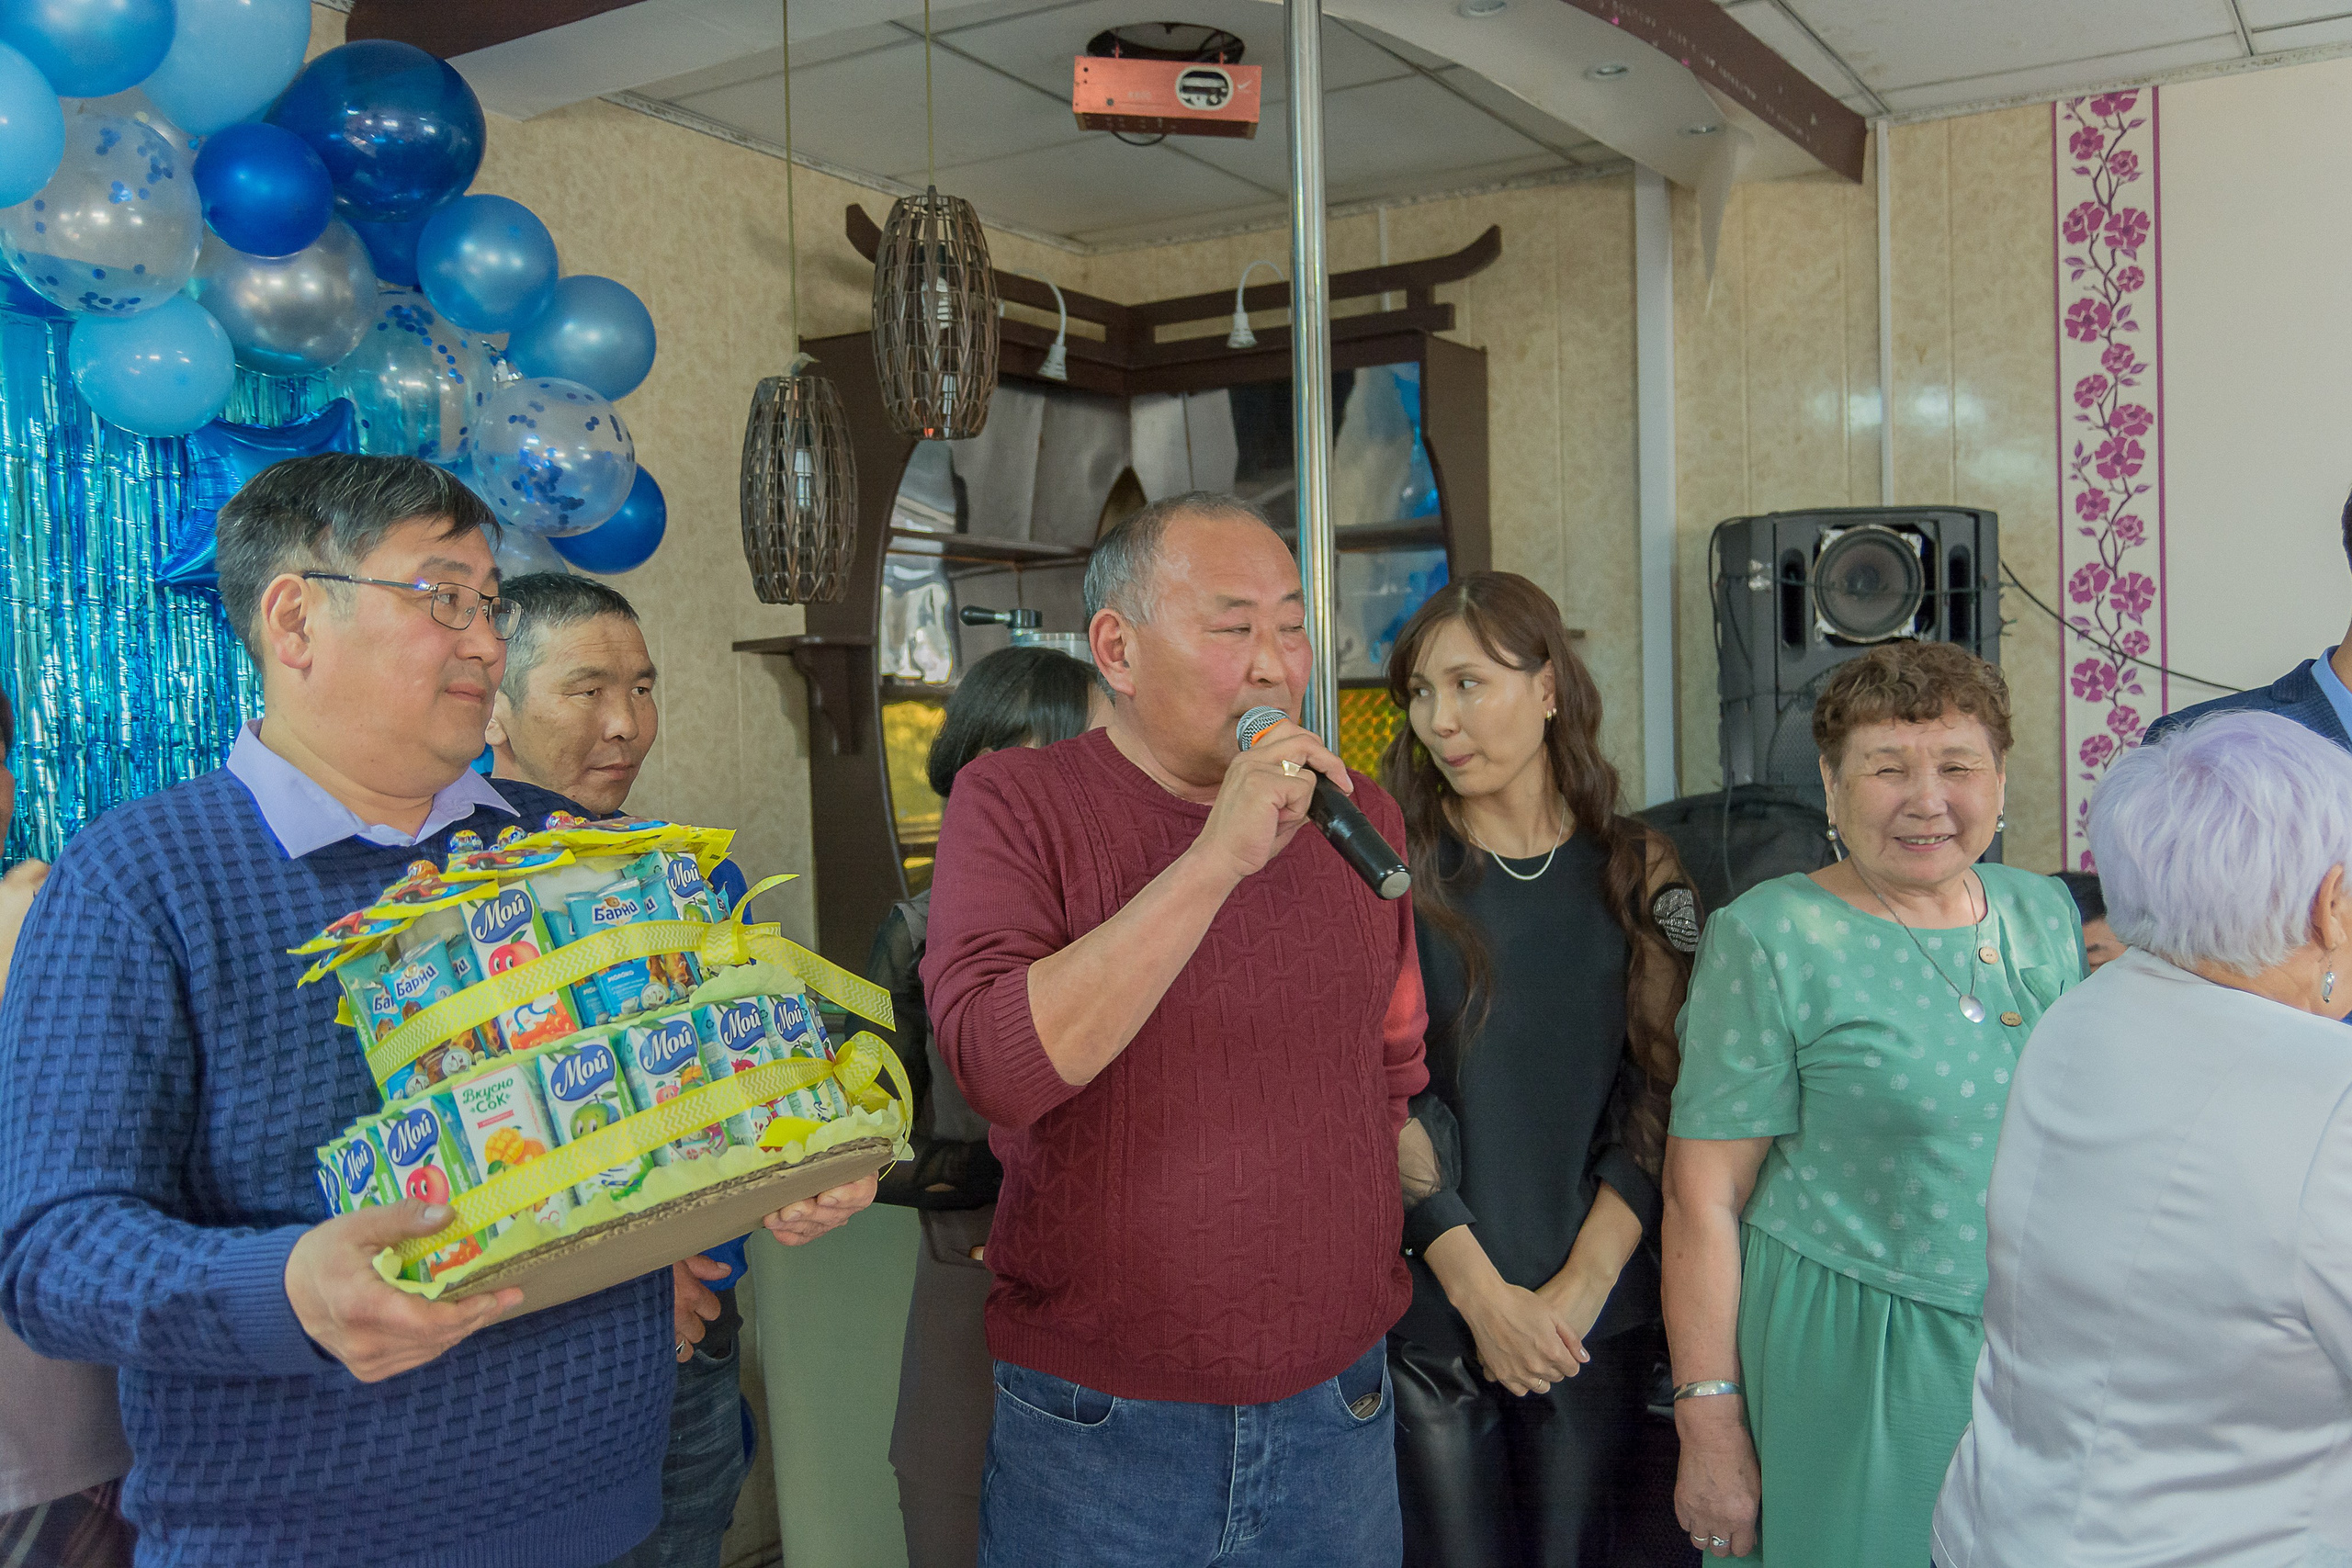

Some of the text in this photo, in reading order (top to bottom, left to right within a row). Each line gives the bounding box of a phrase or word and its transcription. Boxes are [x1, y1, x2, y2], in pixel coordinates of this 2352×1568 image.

[671, 863, 700, 891] Мой
[475, 894, 526, 941] Мой
[594, 901, 639, 922] Барни
[396, 964, 436, 998] Барни
[723, 1009, 762, 1045] Мой
[777, 1004, 804, 1035] Мой
[643, 1025, 693, 1070] Мой
[462, 1077, 514, 1104] Вкусно
[554, 1049, 609, 1098] Мой
[390, 1112, 433, 1163] Мой
[345, 1144, 369, 1190] Мой
